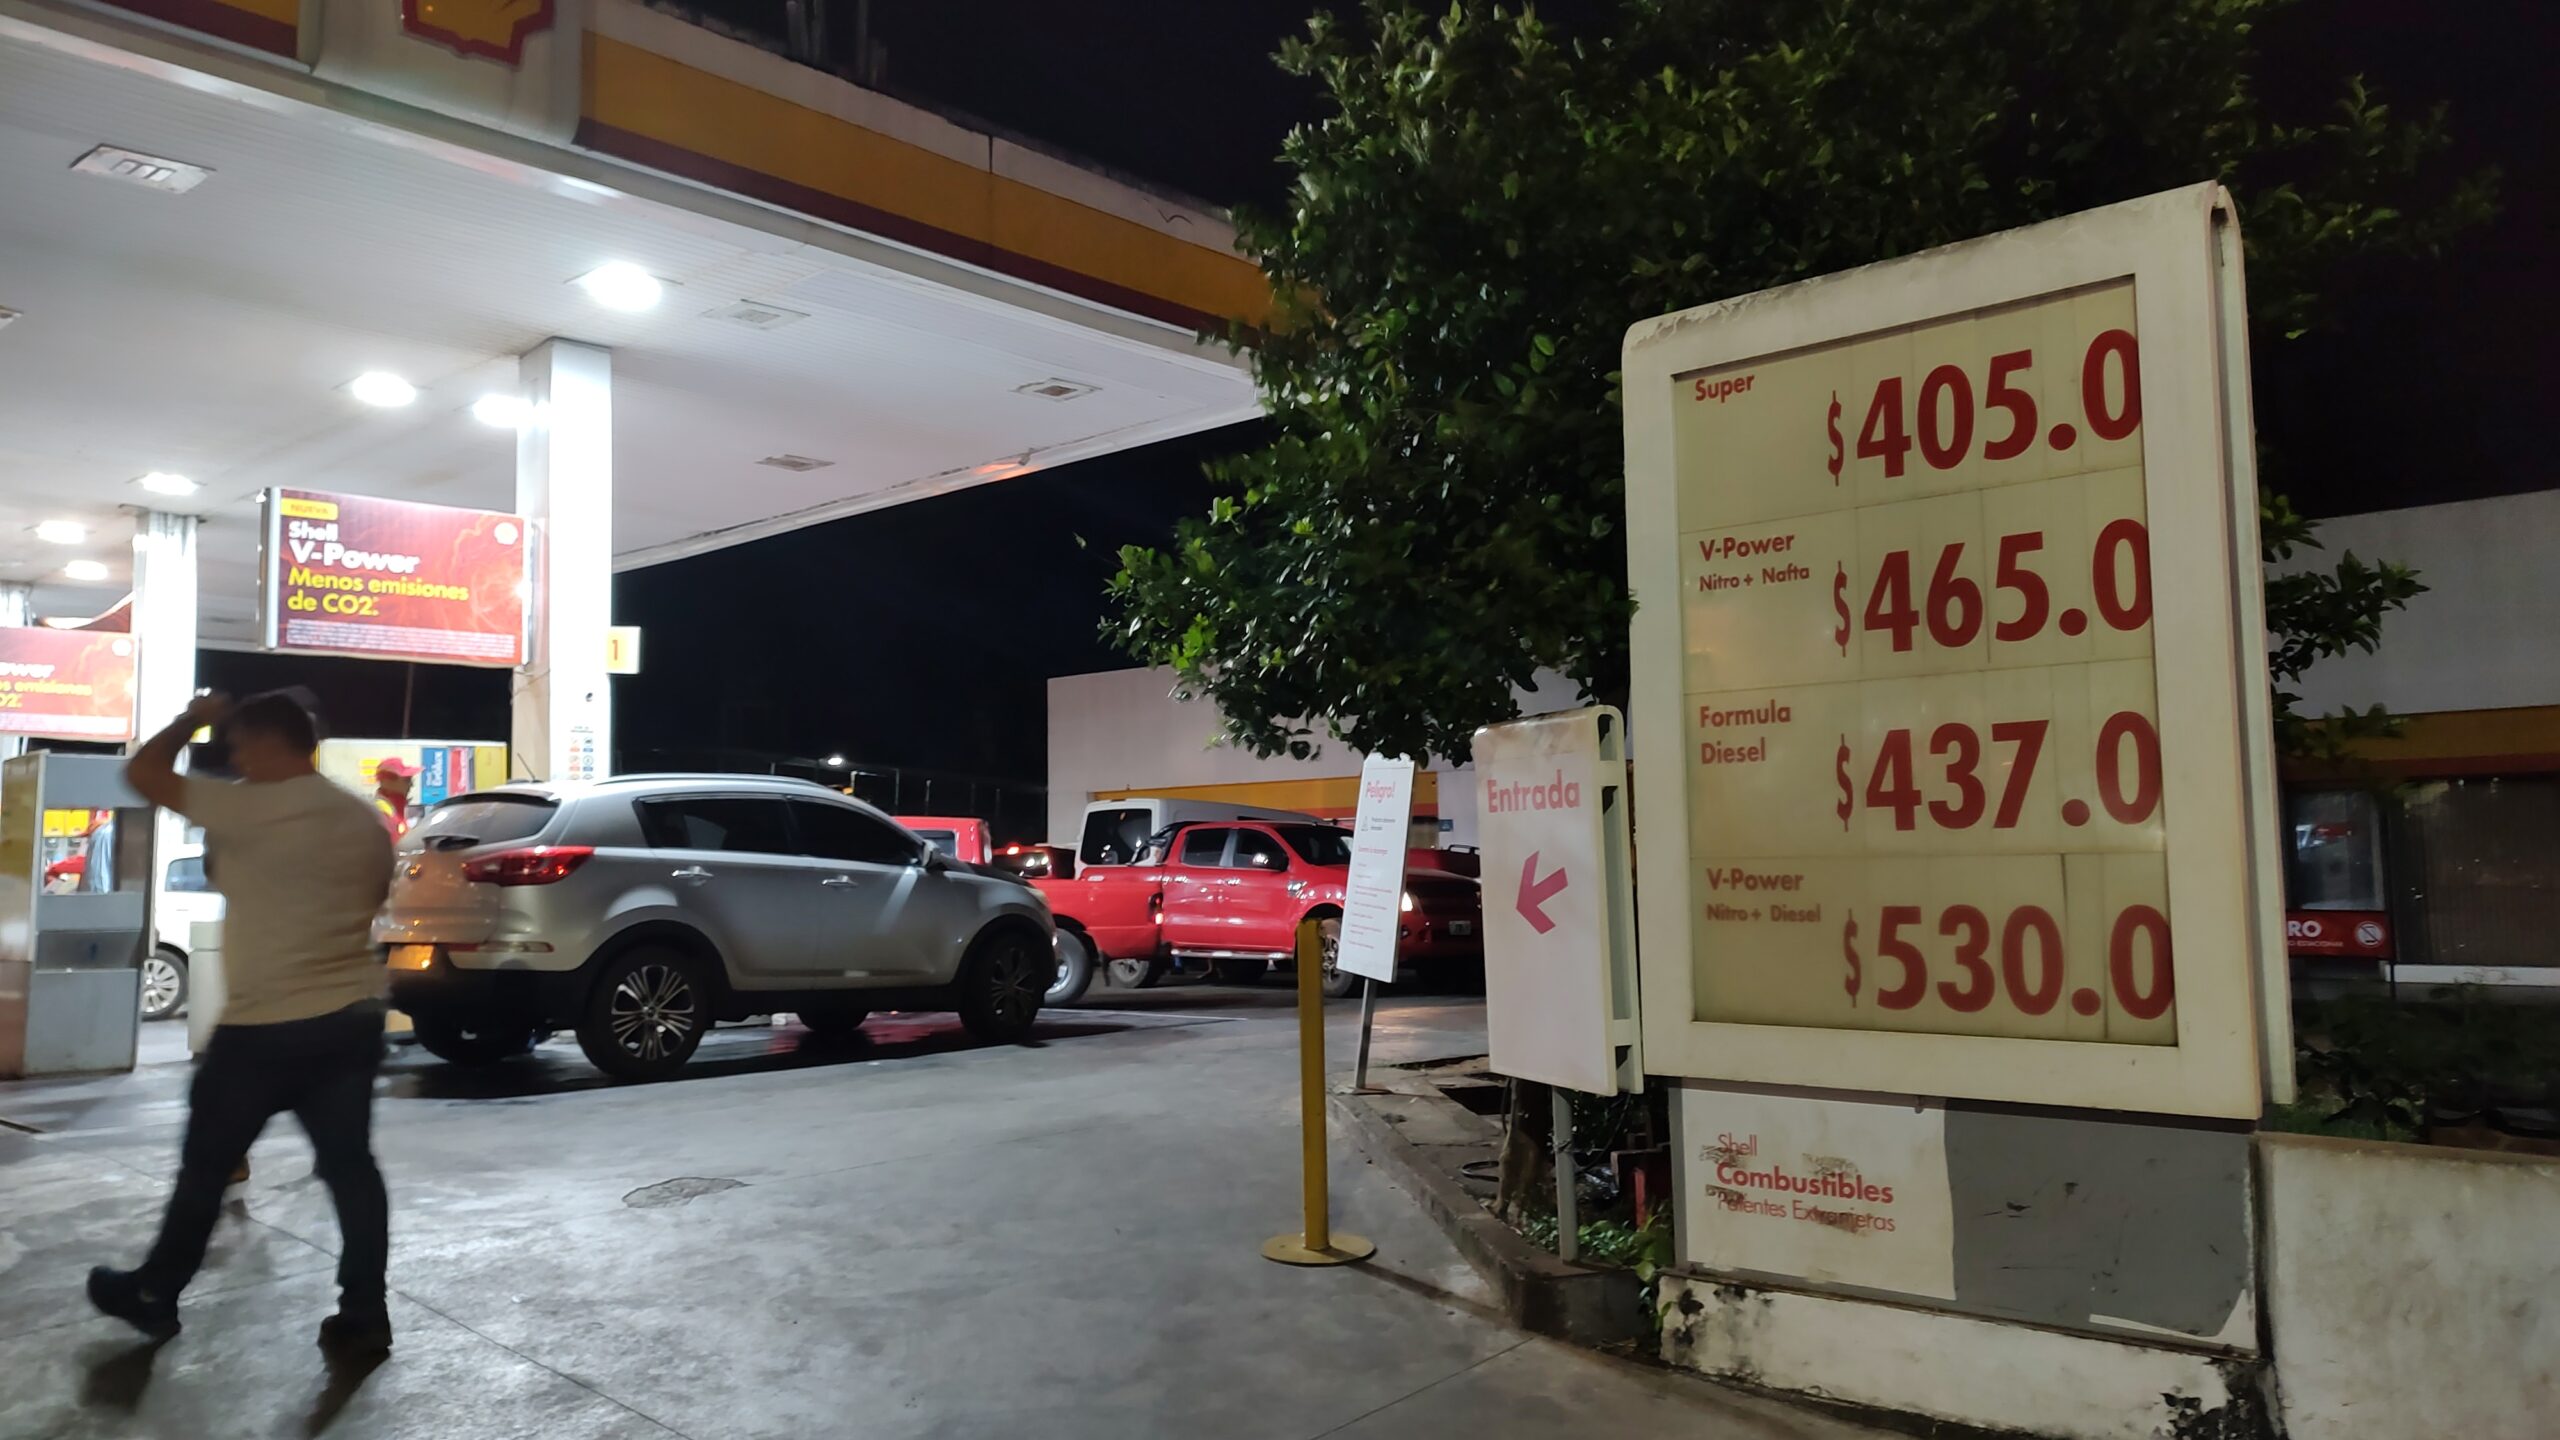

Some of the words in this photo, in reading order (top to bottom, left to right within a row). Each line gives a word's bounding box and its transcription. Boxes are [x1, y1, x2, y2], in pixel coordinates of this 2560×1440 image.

[1695, 373, 1755, 402] Super
[288, 521, 338, 542] Shell
[288, 540, 420, 574] V-Power
[1700, 533, 1795, 562] V-Power
[288, 566, 364, 592] Menos
[368, 576, 469, 601] emisiones
[1761, 563, 1810, 585] Nafta
[287, 589, 317, 612] de
[611, 639, 619, 661] 1
[1699, 700, 1792, 728] Formula
[1700, 737, 1766, 765] Diesel
[1487, 769, 1581, 813] Entrada
[1706, 867, 1803, 892] V-Power
[1770, 904, 1821, 923] Diesel
[1718, 1132, 1758, 1158] Shell
[1716, 1161, 1895, 1205] Combustibles
